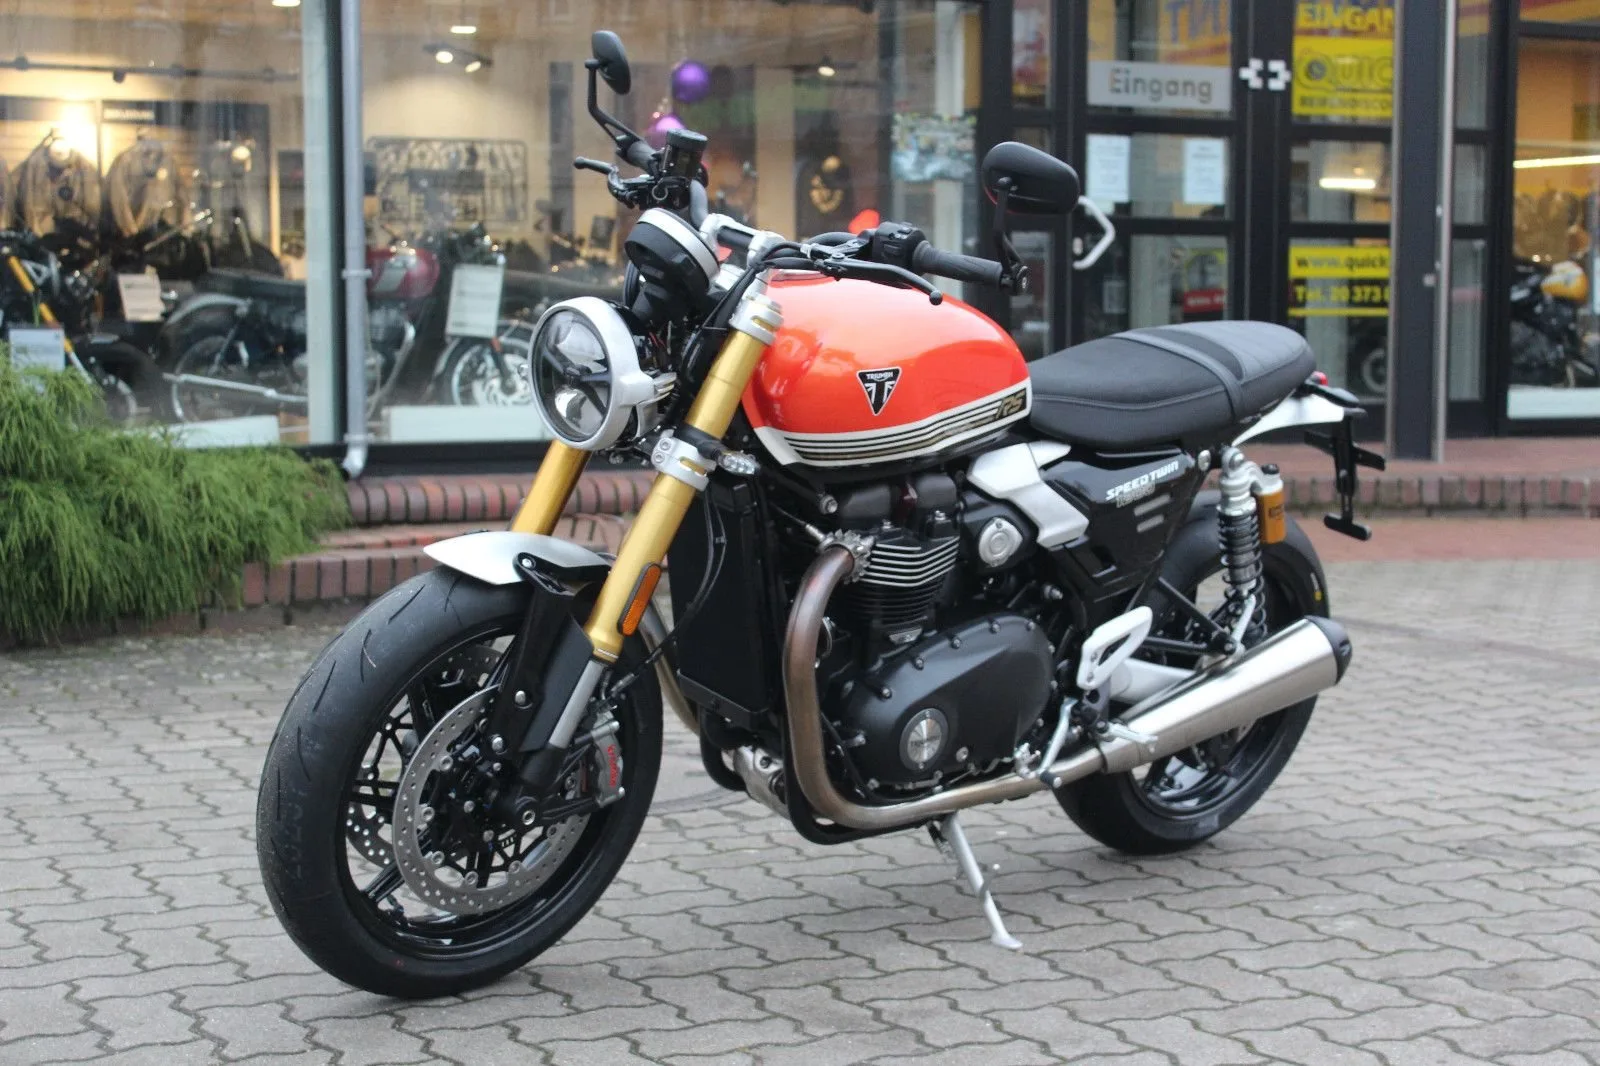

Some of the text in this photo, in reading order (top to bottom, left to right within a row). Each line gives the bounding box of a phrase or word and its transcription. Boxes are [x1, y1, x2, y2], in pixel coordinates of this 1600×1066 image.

[1108, 67, 1213, 104] Eingang
[1105, 473, 1150, 501] SPEED
[1149, 460, 1179, 481] TWIN
